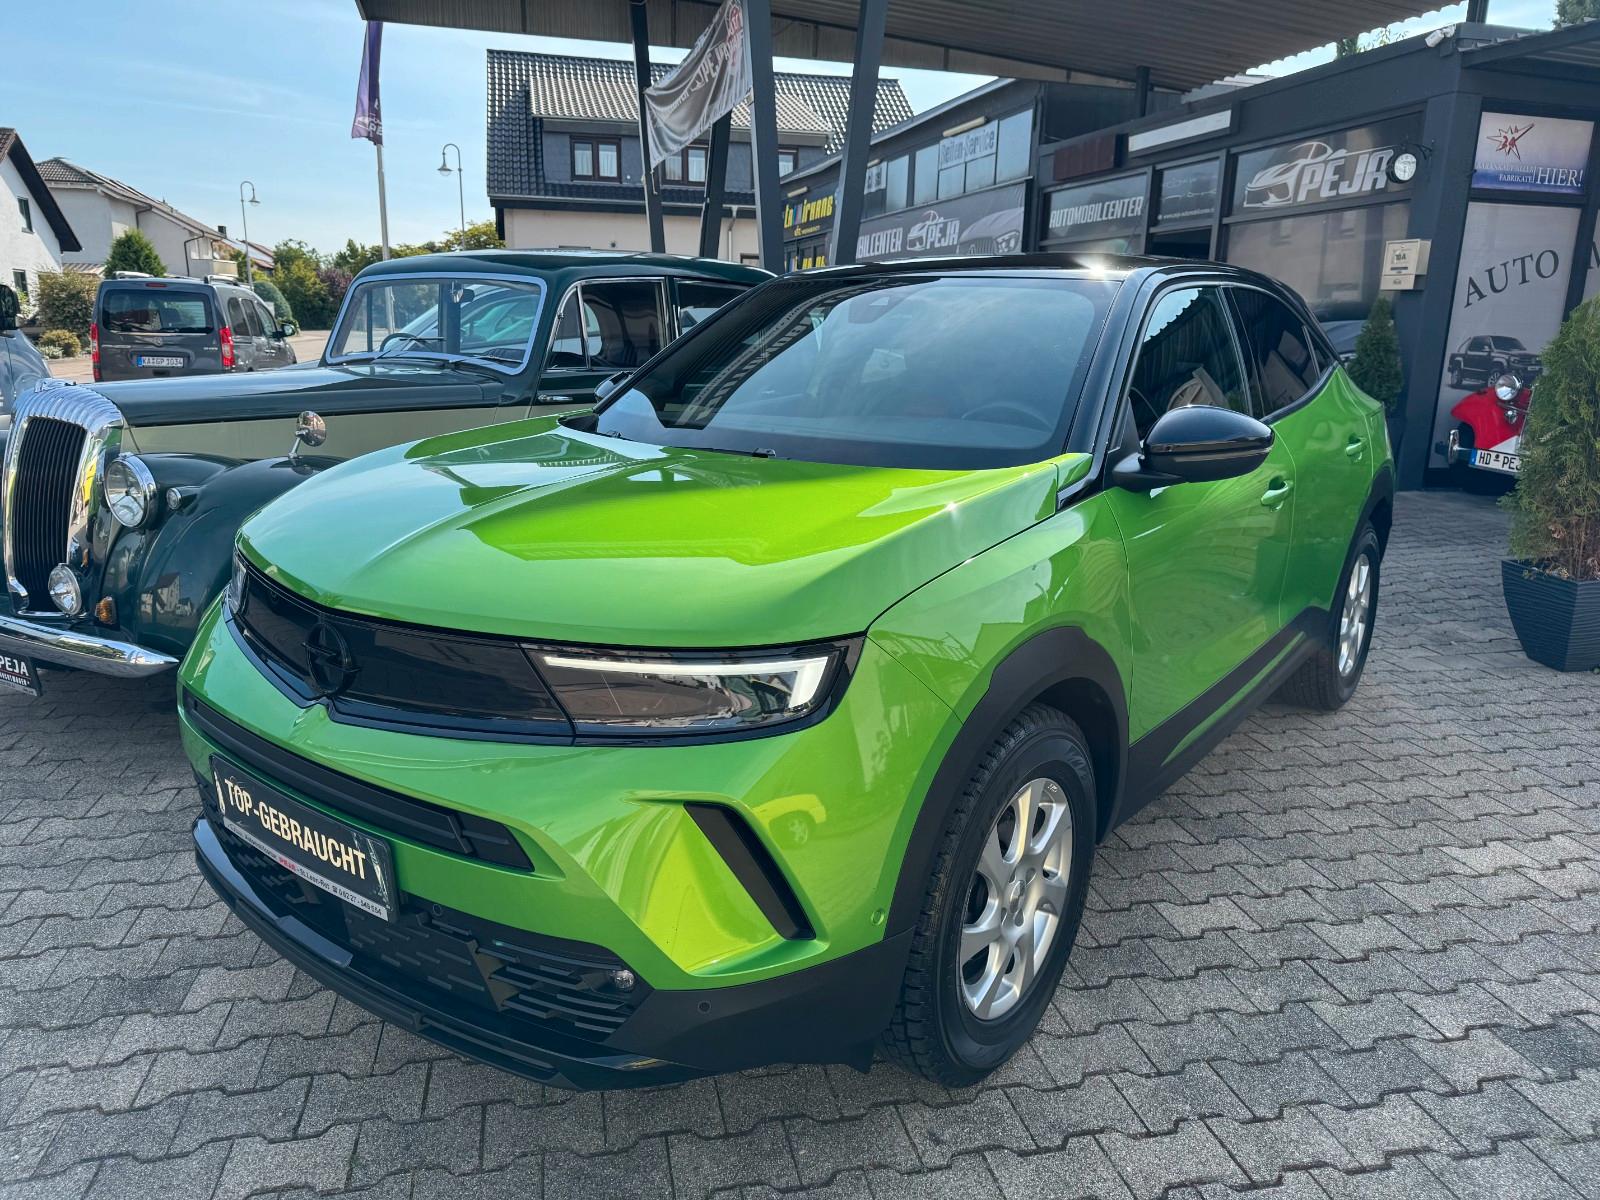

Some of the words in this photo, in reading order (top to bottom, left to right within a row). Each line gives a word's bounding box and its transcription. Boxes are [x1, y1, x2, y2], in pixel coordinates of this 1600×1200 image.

[1297, 149, 1394, 202] PEJA
[1499, 173, 1534, 184] FABRIKATE
[1536, 166, 1584, 188] HIER!
[1049, 196, 1144, 229] AUTOMOBILCENTER
[926, 219, 961, 249] PEJA
[1464, 249, 1560, 308] AUTO
[1479, 451, 1491, 465] HD
[0, 655, 29, 677] PEJA
[224, 778, 366, 880] TOP-GEBRAUCHT
